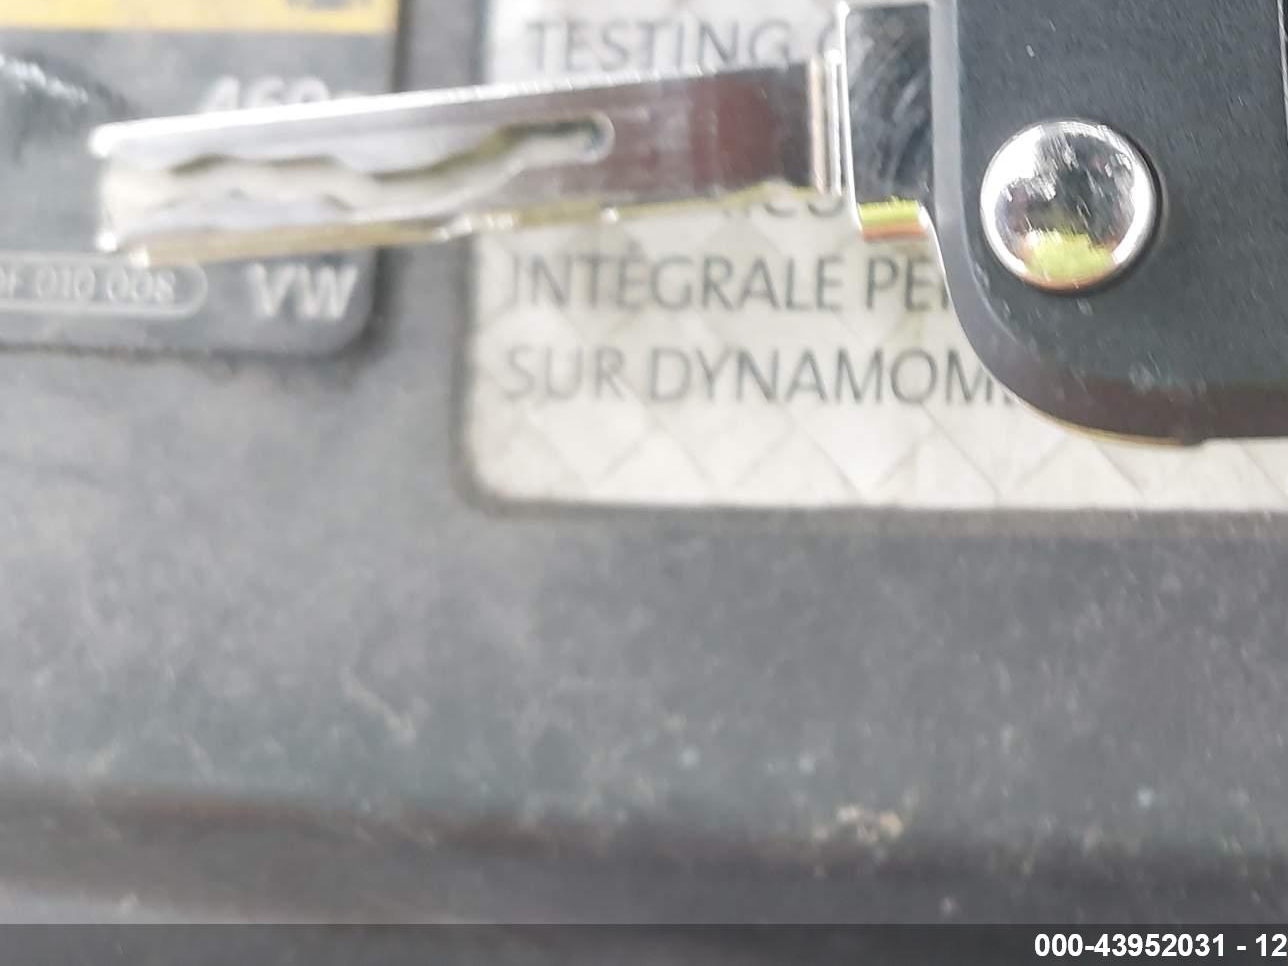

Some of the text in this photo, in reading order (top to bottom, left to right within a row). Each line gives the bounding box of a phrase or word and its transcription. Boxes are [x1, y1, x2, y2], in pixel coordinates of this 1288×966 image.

[526, 18, 791, 70] TESTING
[247, 262, 359, 322] VW
[502, 343, 1016, 406] SUR DYNAMOM
